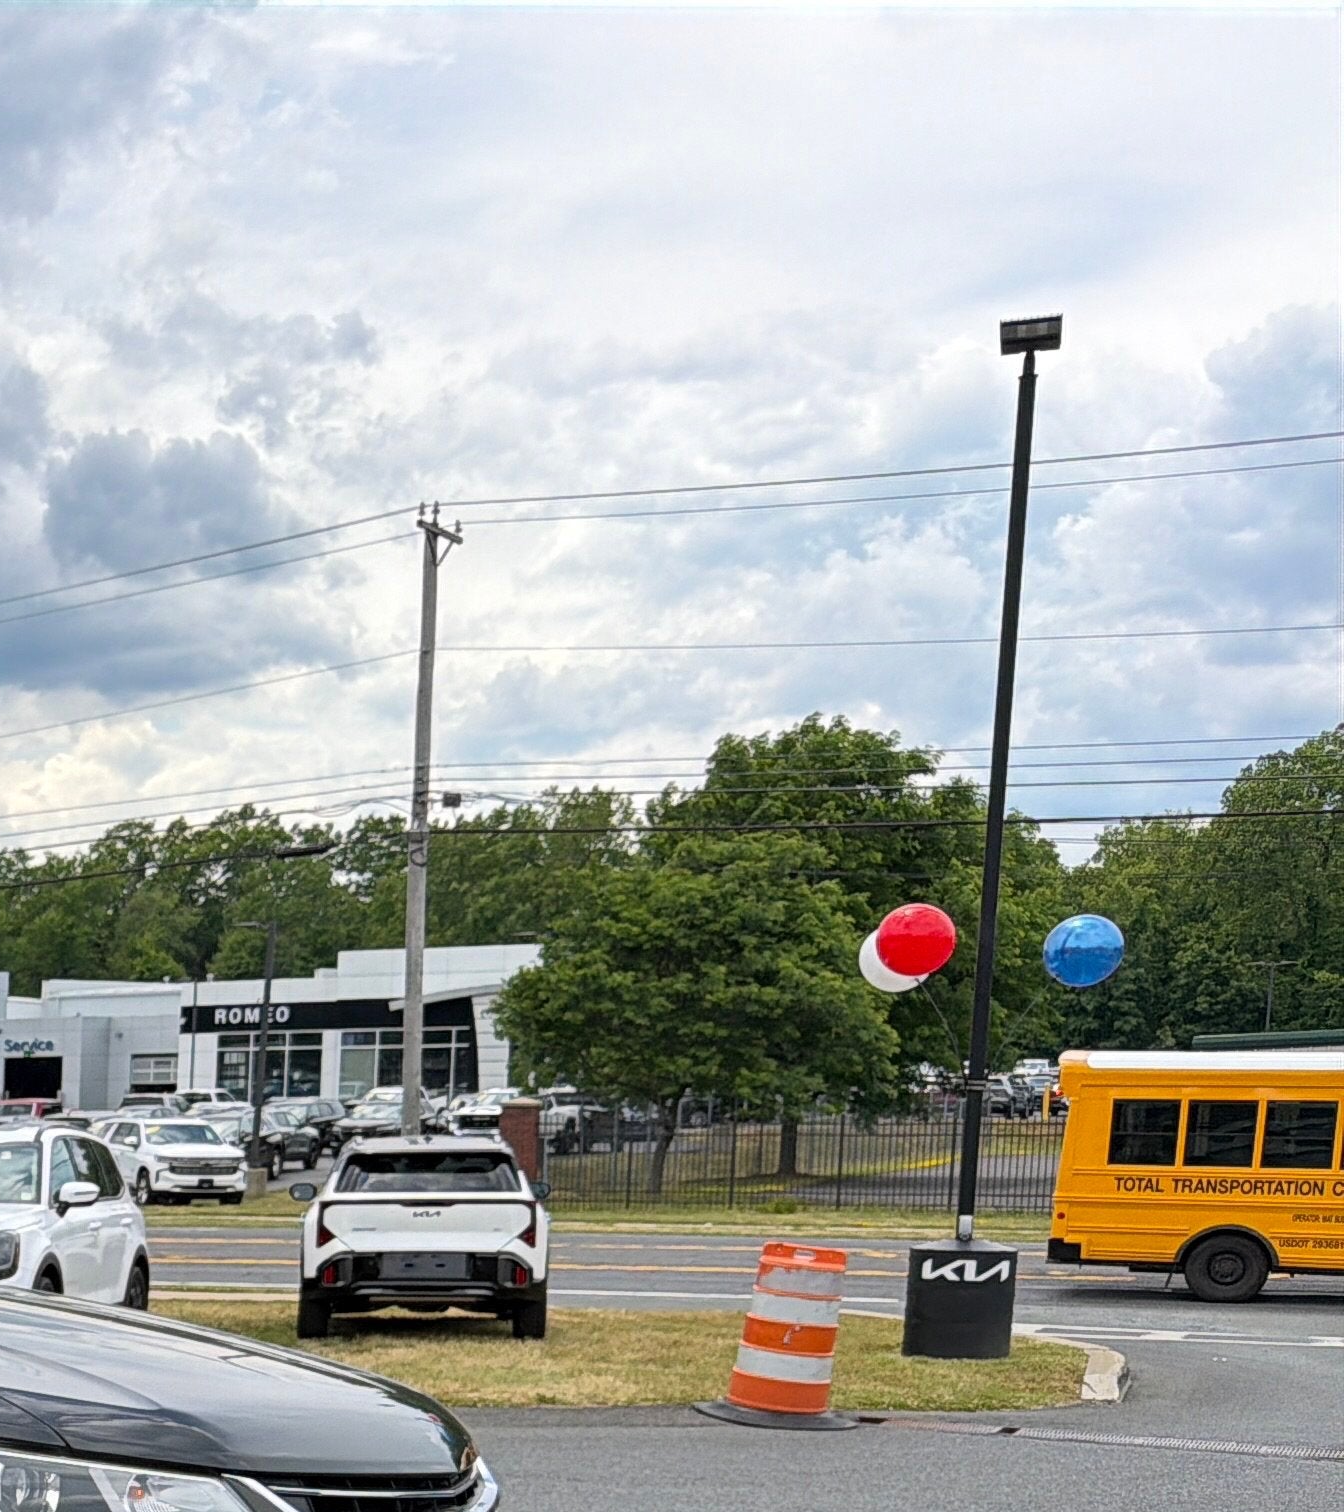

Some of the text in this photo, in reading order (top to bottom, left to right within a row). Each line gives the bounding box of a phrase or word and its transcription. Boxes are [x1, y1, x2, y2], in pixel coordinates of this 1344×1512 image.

[4, 1038, 55, 1053] Service
[1114, 1176, 1164, 1193] TOTAL
[1172, 1178, 1325, 1196] TRANSPORTATION
[1279, 1239, 1309, 1248] USDOT
[921, 1257, 1010, 1282] KIA
